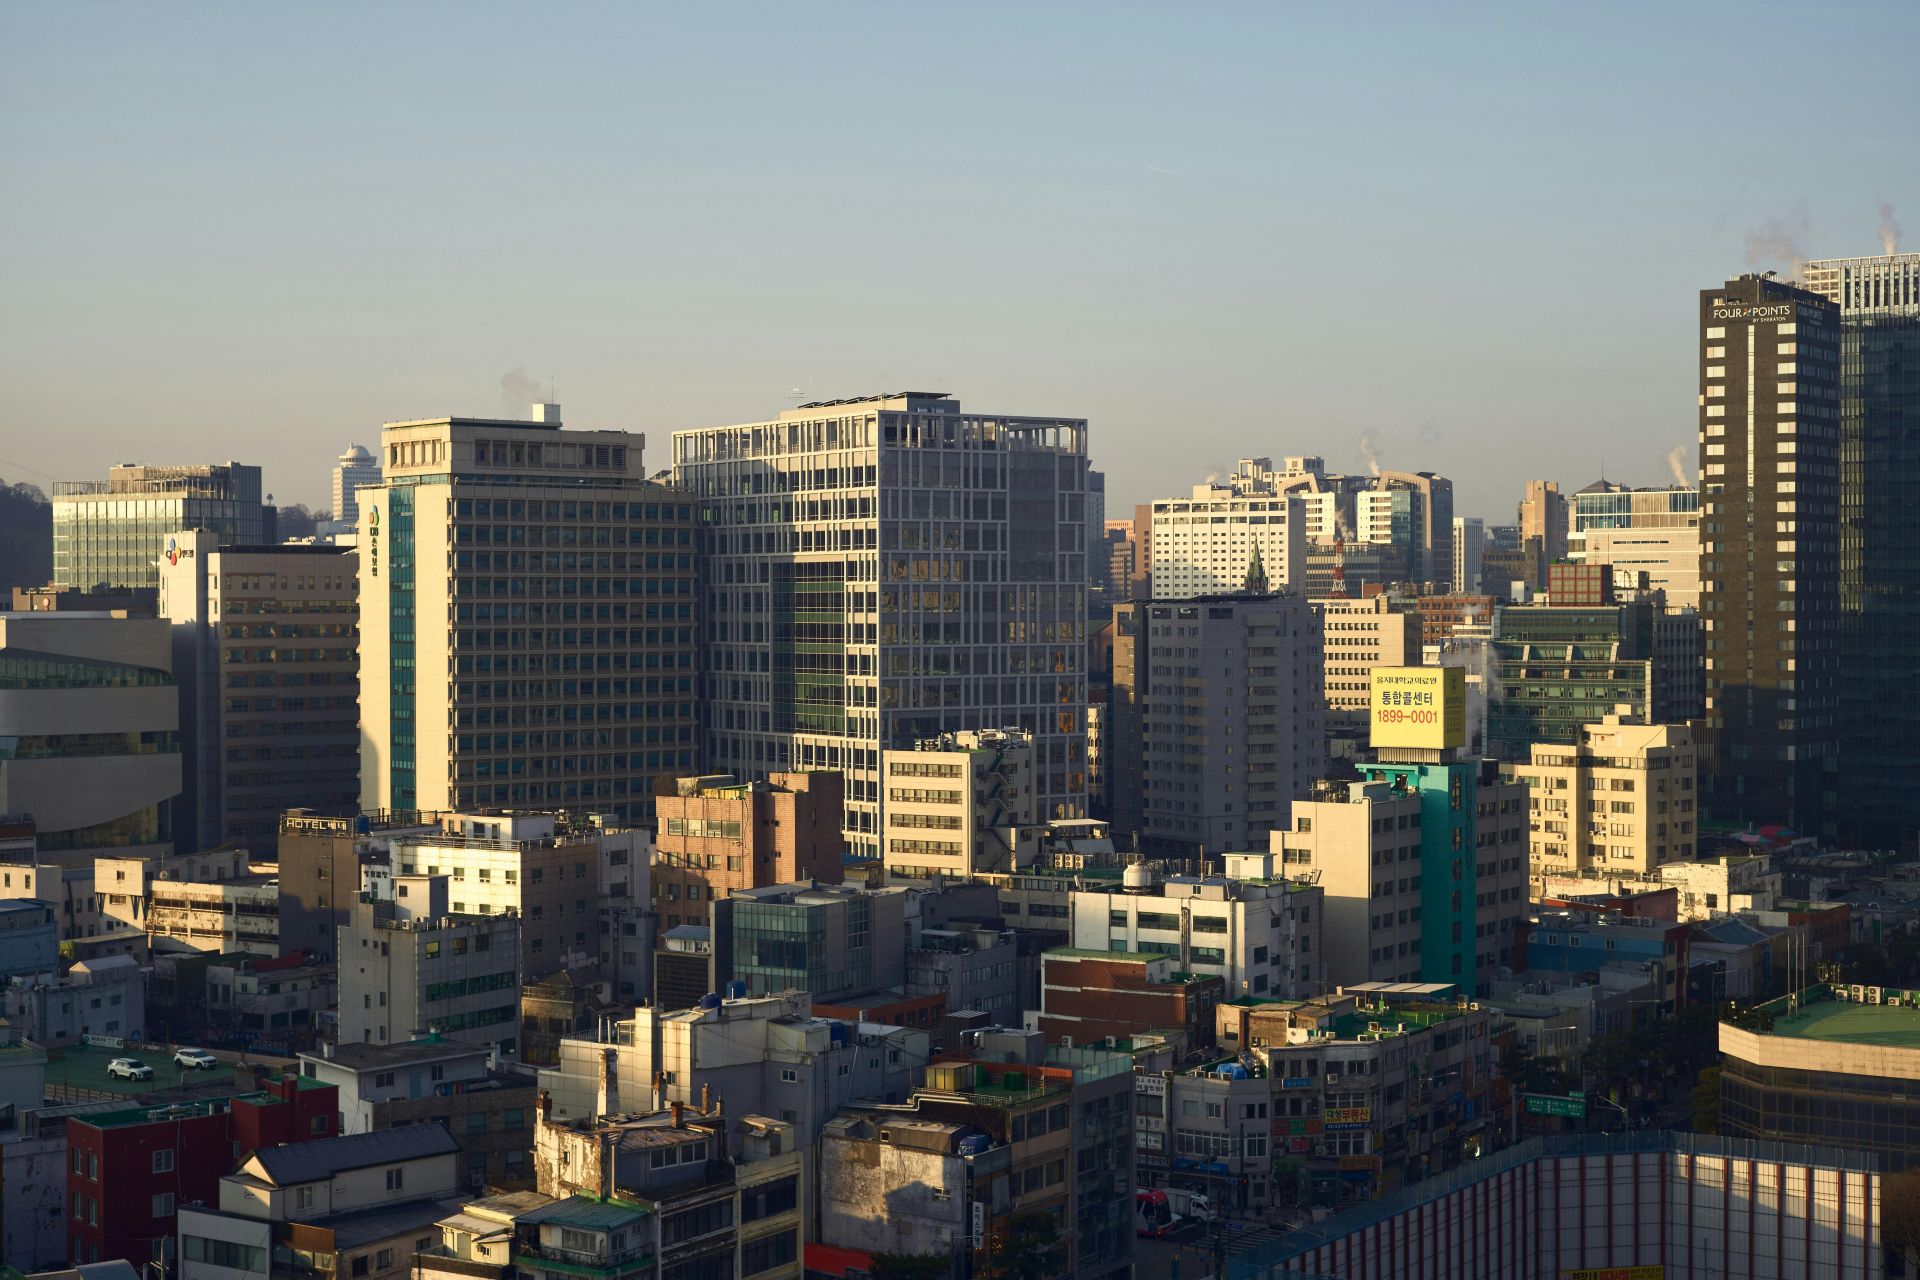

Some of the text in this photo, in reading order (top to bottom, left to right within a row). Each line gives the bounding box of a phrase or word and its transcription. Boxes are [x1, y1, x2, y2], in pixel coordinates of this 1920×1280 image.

[1713, 308, 1742, 319] FOUR
[1752, 305, 1790, 316] POINTS
[1376, 676, 1437, 685] 을지대학교의료원
[1382, 691, 1433, 706] 통합콜센터
[1377, 709, 1438, 724] 1899-0001
[286, 819, 327, 830] HOTEL
